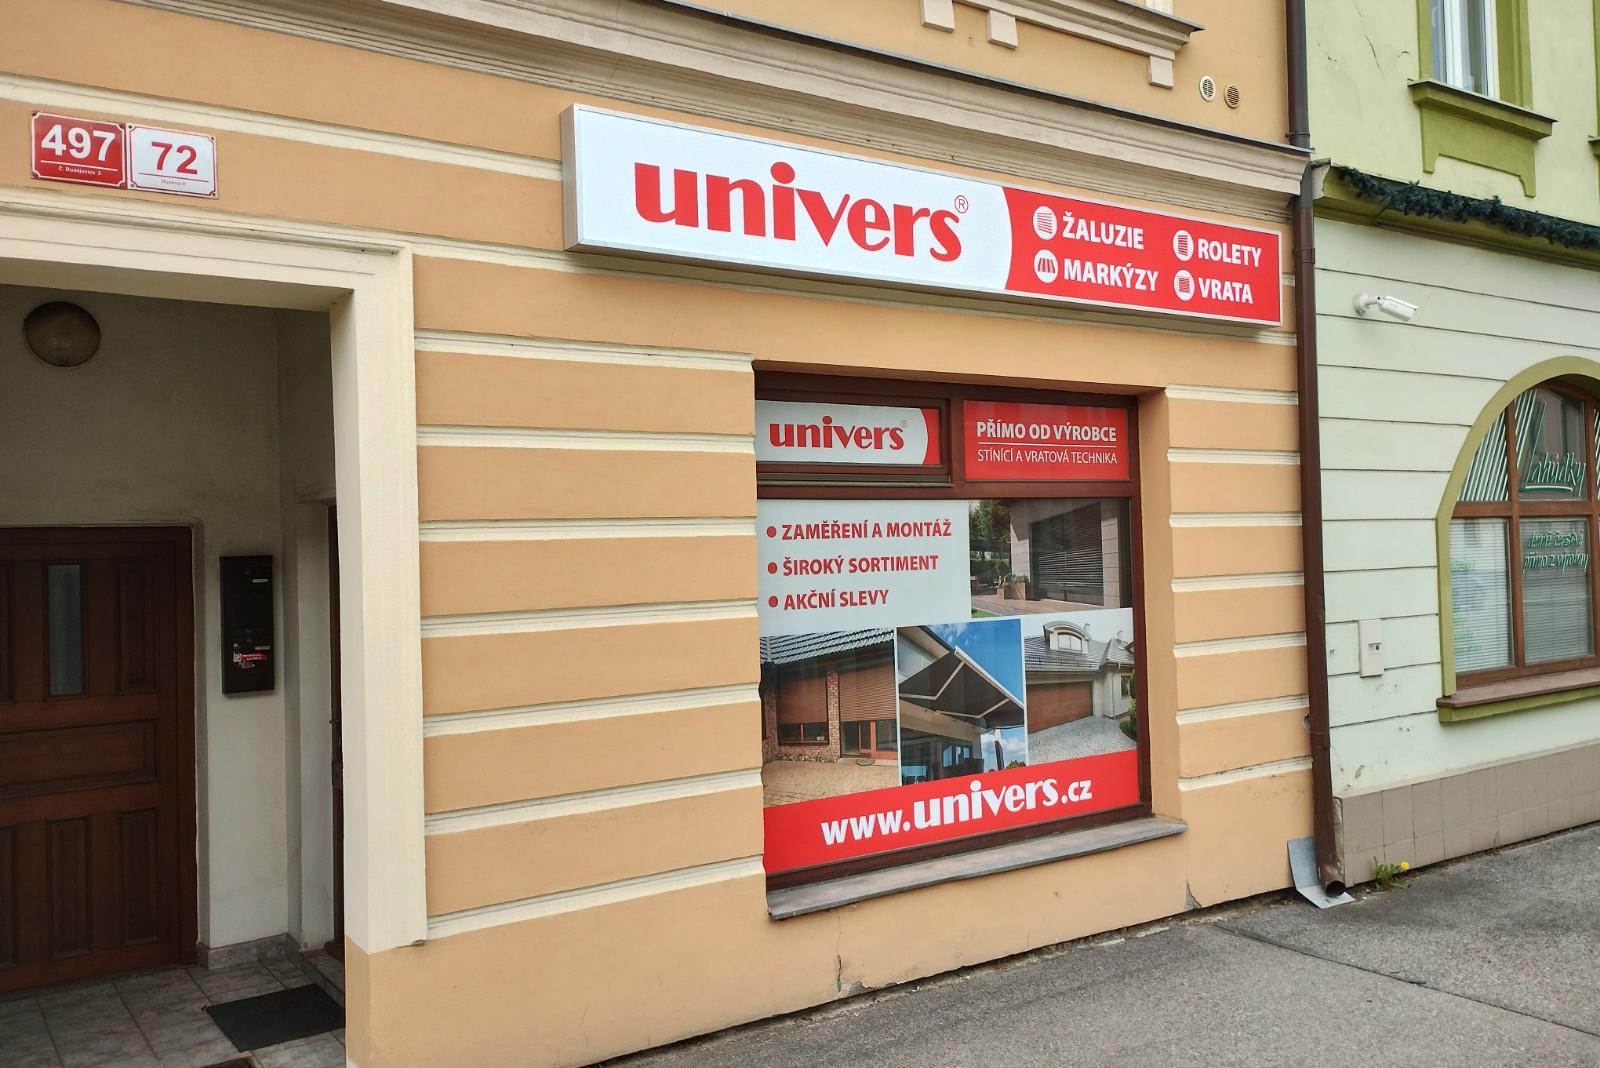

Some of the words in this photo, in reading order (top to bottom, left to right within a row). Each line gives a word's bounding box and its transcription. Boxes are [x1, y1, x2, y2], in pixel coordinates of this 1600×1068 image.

[41, 124, 116, 162] 497
[151, 141, 198, 175] 72
[1062, 211, 1145, 250] ŽALUZIE
[1198, 238, 1262, 268] ROLETY
[1063, 258, 1159, 292] MARKÝZY
[1198, 277, 1254, 304] VRATA
[976, 418, 1026, 439] PŘÍMO
[1028, 423, 1051, 440] OD
[1053, 421, 1117, 442] VÝROBCE
[977, 448, 1014, 463] STÍNÍCÍ
[1015, 450, 1024, 463] A
[1024, 449, 1070, 464] VRATOVÁ
[1070, 451, 1118, 465] TECHNIKA
[781, 519, 869, 541] ZAMĚŘENÍ
[871, 523, 883, 538] A
[886, 518, 952, 538] MONTÁŽ
[782, 554, 845, 577] ŠIROKÝ
[848, 554, 939, 575] SORTIMENT
[783, 587, 836, 611] AKČNÍ
[839, 589, 889, 608] SLEVY
[820, 779, 1093, 846] www.univers.cz
